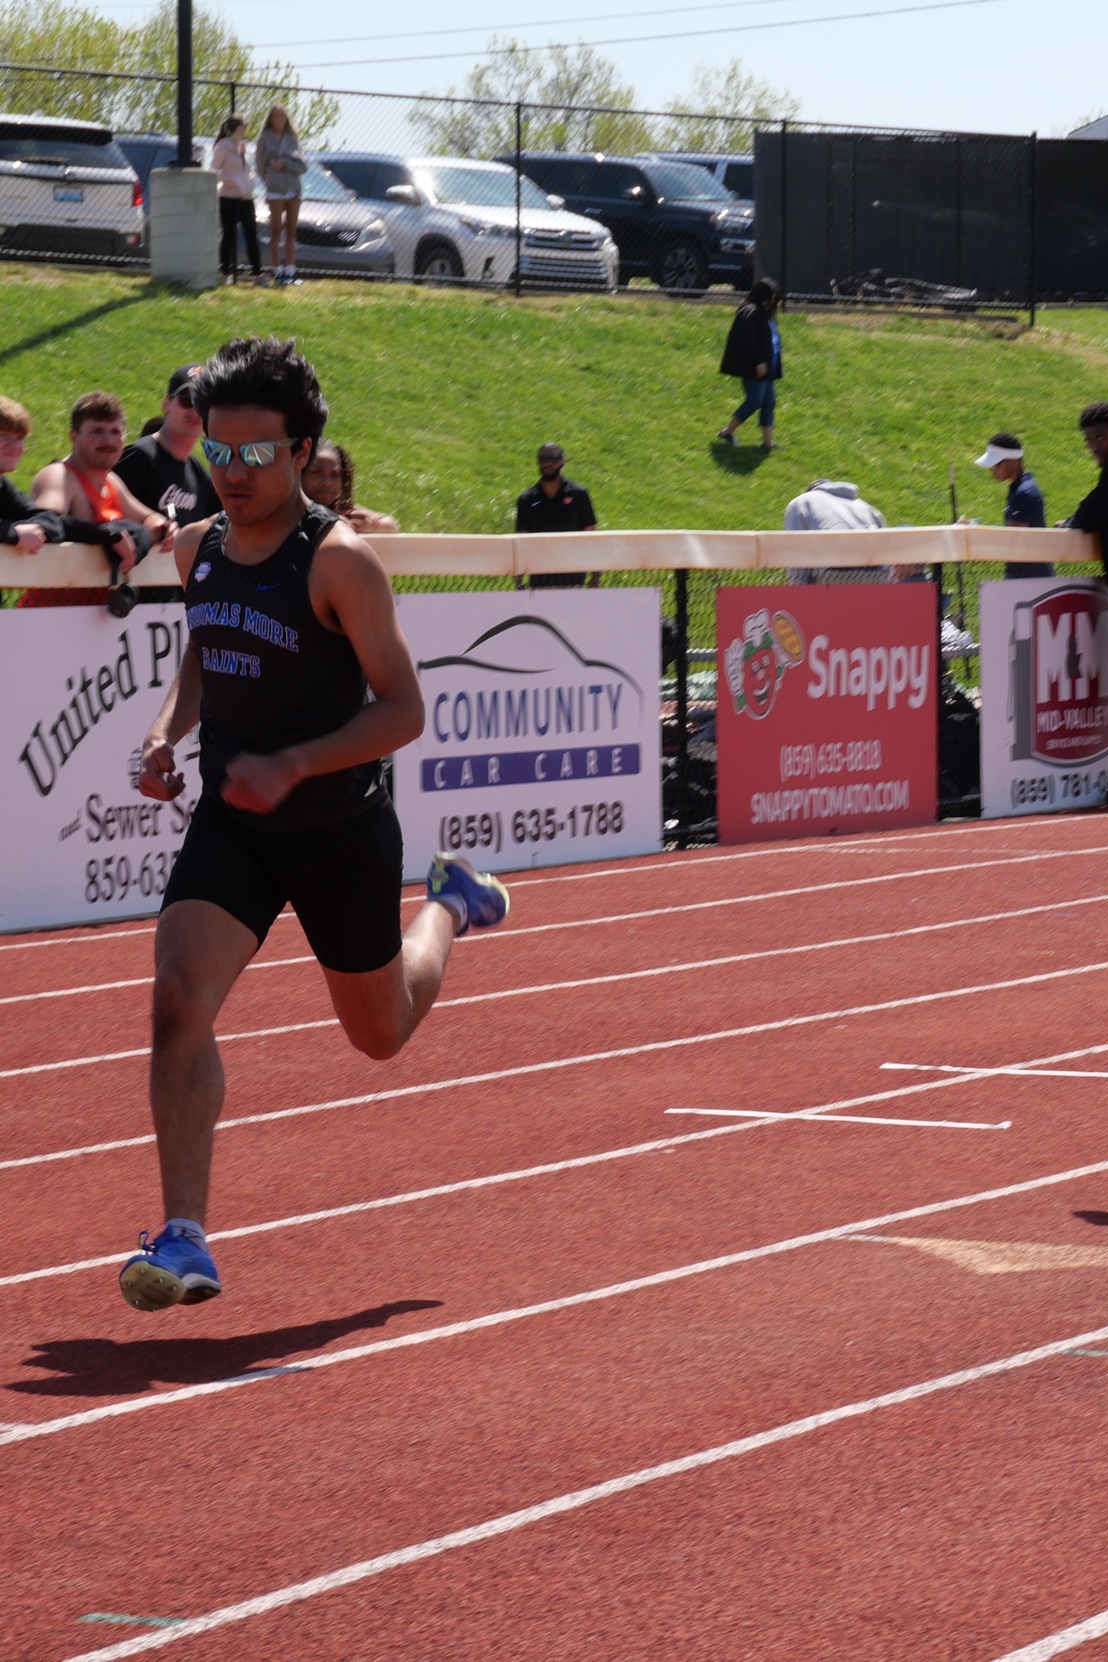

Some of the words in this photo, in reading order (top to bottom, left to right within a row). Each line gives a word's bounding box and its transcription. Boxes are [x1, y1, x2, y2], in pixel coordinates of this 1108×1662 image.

[243, 606, 299, 653] MORE
[201, 646, 261, 678] SAINTS
[806, 633, 930, 712] Snappy
[18, 629, 139, 798] United
[433, 683, 623, 743] COMMUNITY
[434, 757, 501, 789] CAR
[534, 747, 623, 781] CARE
[780, 742, 816, 783] (859)
[751, 779, 910, 824] SNAPPYTOMATO.COM
[1011, 773, 1055, 809] (859)
[85, 792, 163, 844] Sewer
[439, 811, 503, 853] (859)
[512, 800, 624, 844] 635-1788
